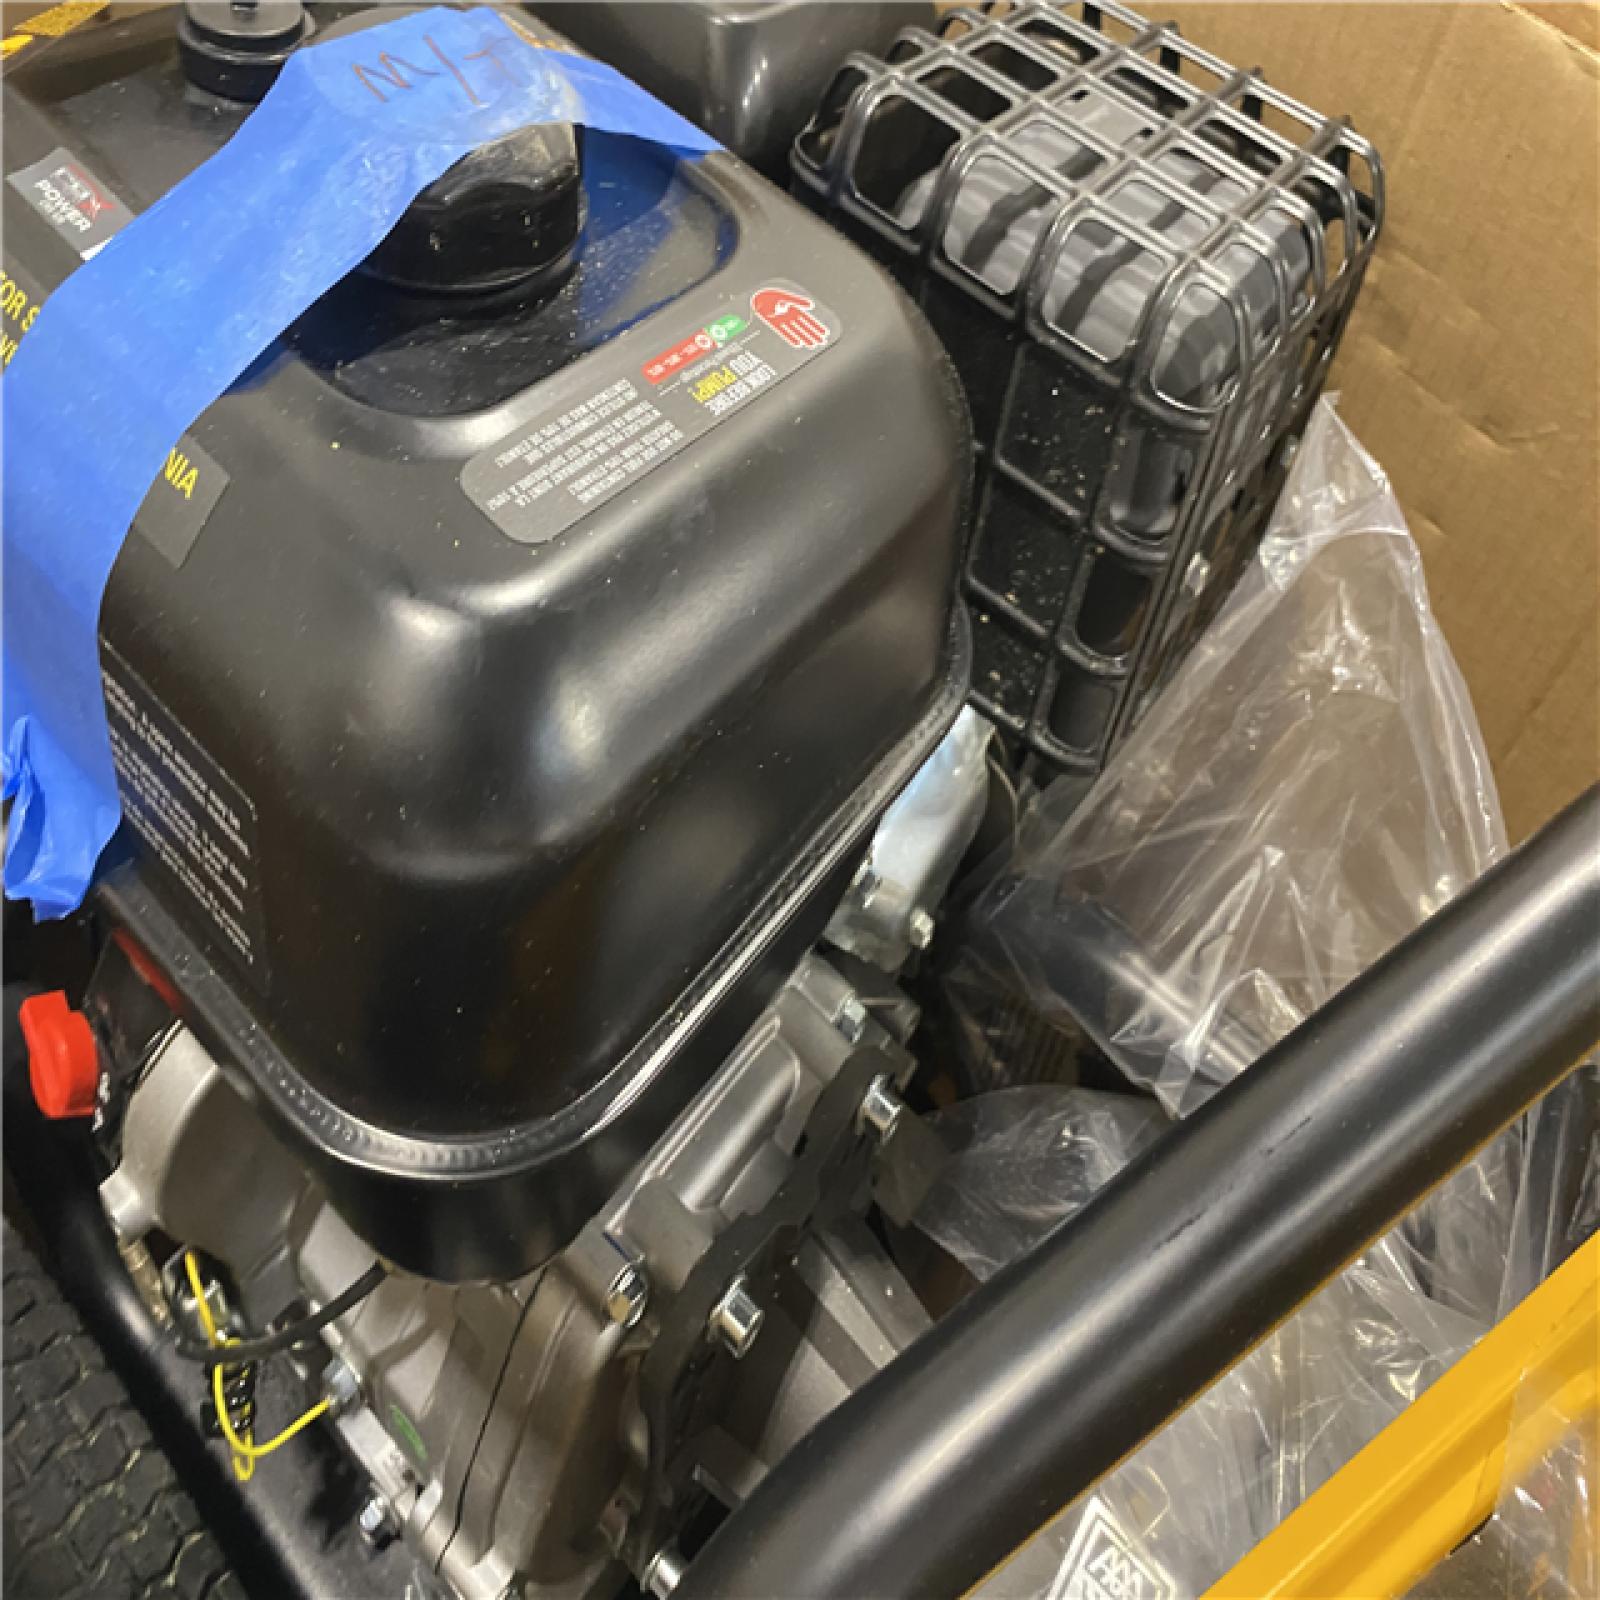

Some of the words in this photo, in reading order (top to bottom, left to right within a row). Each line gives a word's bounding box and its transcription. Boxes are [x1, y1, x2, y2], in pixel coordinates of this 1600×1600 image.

[34, 180, 90, 231] POWER
[729, 351, 763, 375] YOU
[745, 364, 776, 388] LOOK
[688, 366, 737, 403] PUMP!
[704, 383, 751, 415] BEFORE
